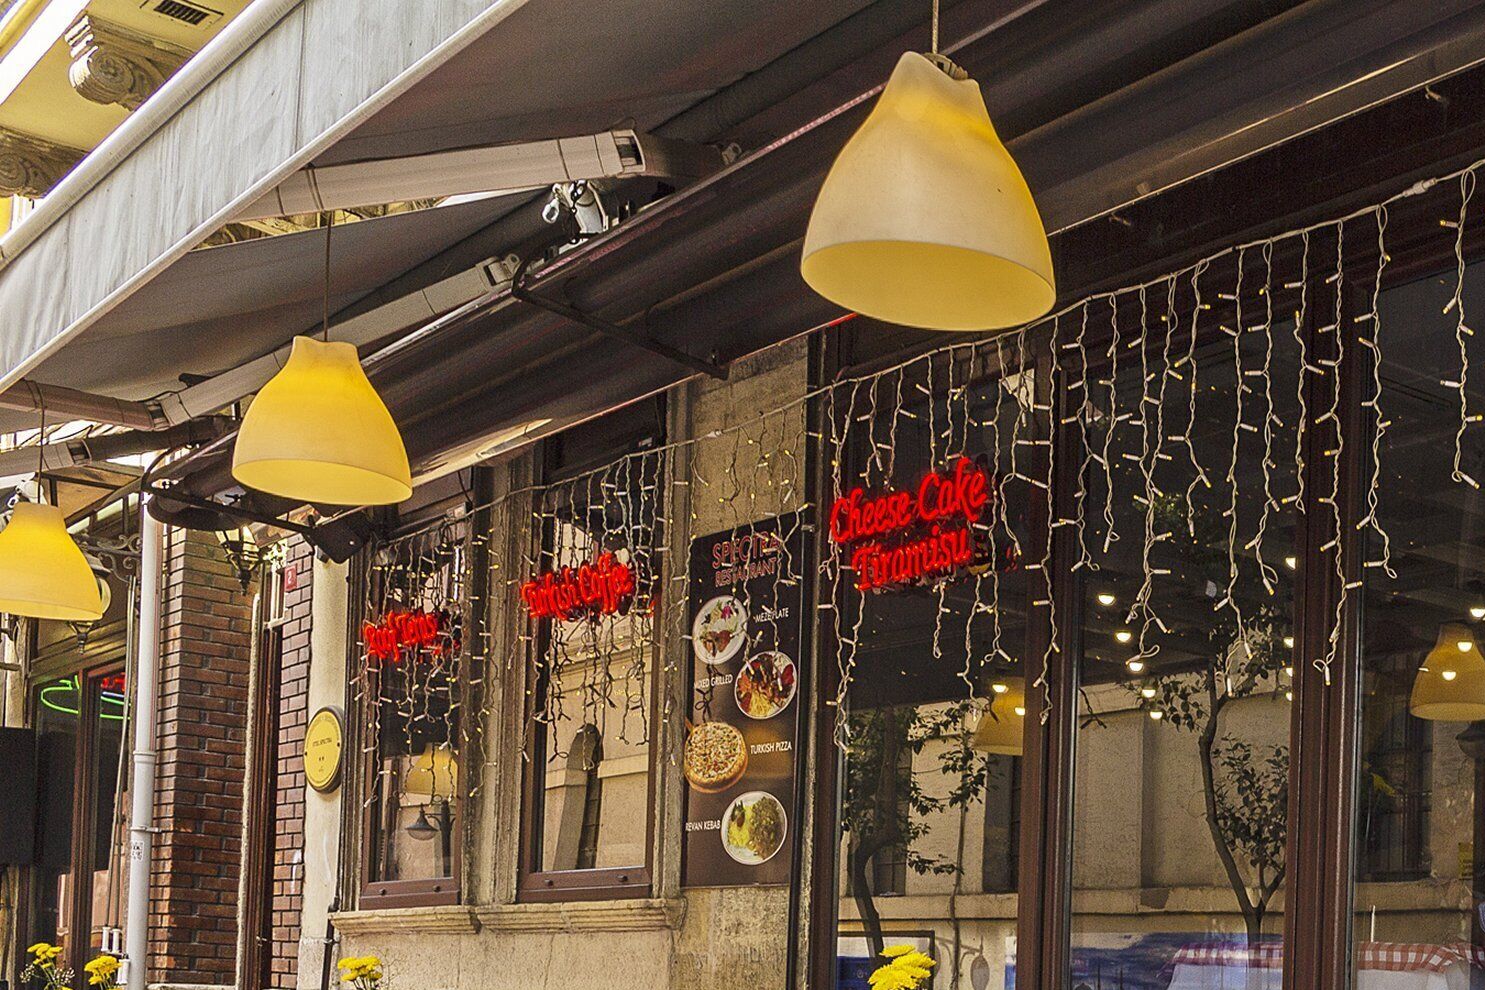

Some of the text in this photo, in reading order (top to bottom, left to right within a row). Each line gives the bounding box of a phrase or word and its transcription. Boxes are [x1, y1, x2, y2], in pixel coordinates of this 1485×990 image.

[830, 456, 988, 543] Cheese Cake
[852, 525, 972, 591] Tiramisu
[750, 741, 792, 755] TURKISH PIZZA
